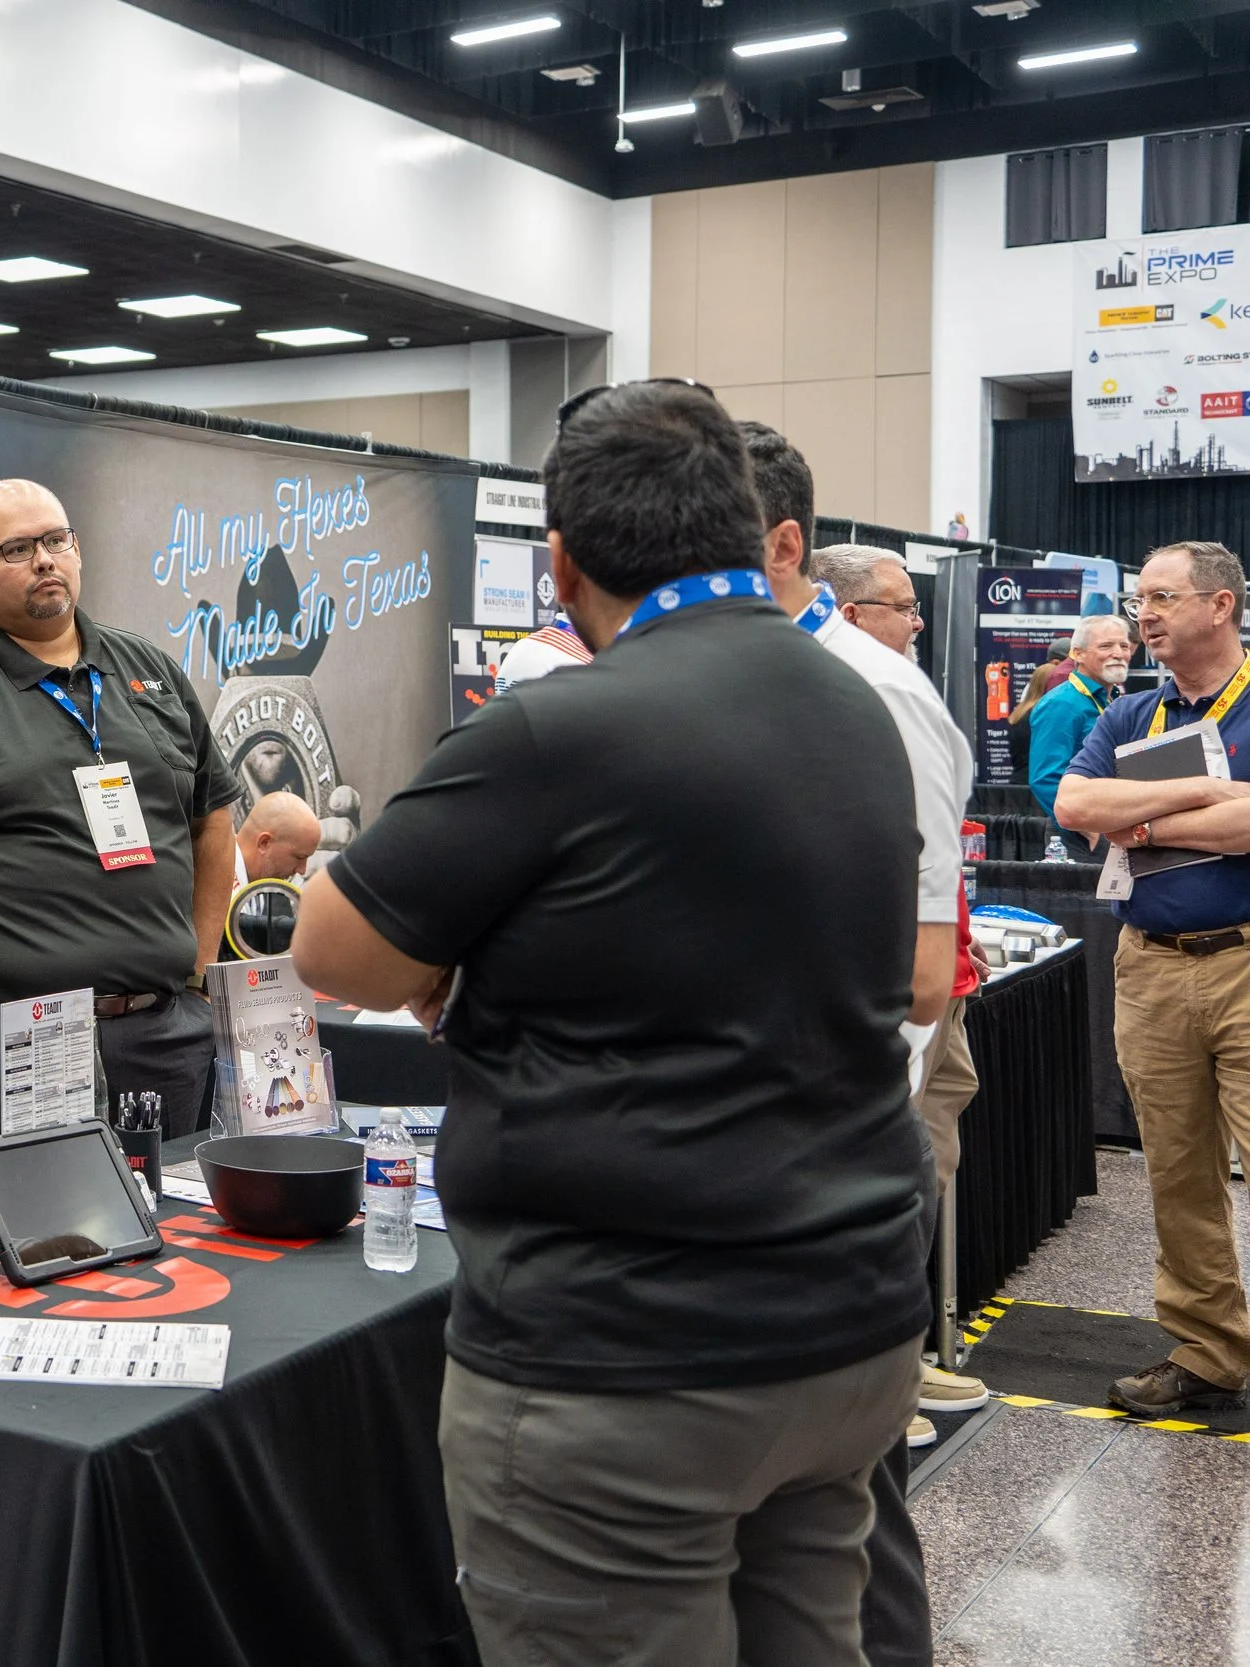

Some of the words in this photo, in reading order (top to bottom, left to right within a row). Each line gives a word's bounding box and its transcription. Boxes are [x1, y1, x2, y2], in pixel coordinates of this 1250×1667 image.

[1147, 246, 1180, 256] THE
[1147, 250, 1234, 271] PRIME
[1147, 267, 1217, 286] EXPO
[1156, 307, 1173, 319] CAT
[1197, 352, 1241, 363] BOLTING
[1086, 396, 1133, 407] SUNBELT
[1204, 396, 1239, 407] AAIT
[1143, 408, 1189, 416] STANDARD
[507, 495, 517, 507] LINE
[151, 502, 211, 598] All
[220, 512, 269, 586] my
[274, 473, 370, 561] Hexes
[995, 584, 1022, 601] ION
[166, 599, 282, 689] Made
[290, 569, 336, 649] In
[342, 549, 431, 630] Texas
[484, 630, 515, 639] BUILDING
[987, 729, 1003, 737] Tiger
[222, 695, 287, 748] TRIOT
[291, 707, 332, 785] BOLT
[108, 853, 147, 866] SPONSOR
[258, 969, 279, 983] TEADIT
[238, 999, 253, 1009] FLUID
[272, 992, 303, 1006] PRODUCTS
[44, 1001, 62, 1015] TEADIT
[386, 1169, 414, 1177] OZARKA
